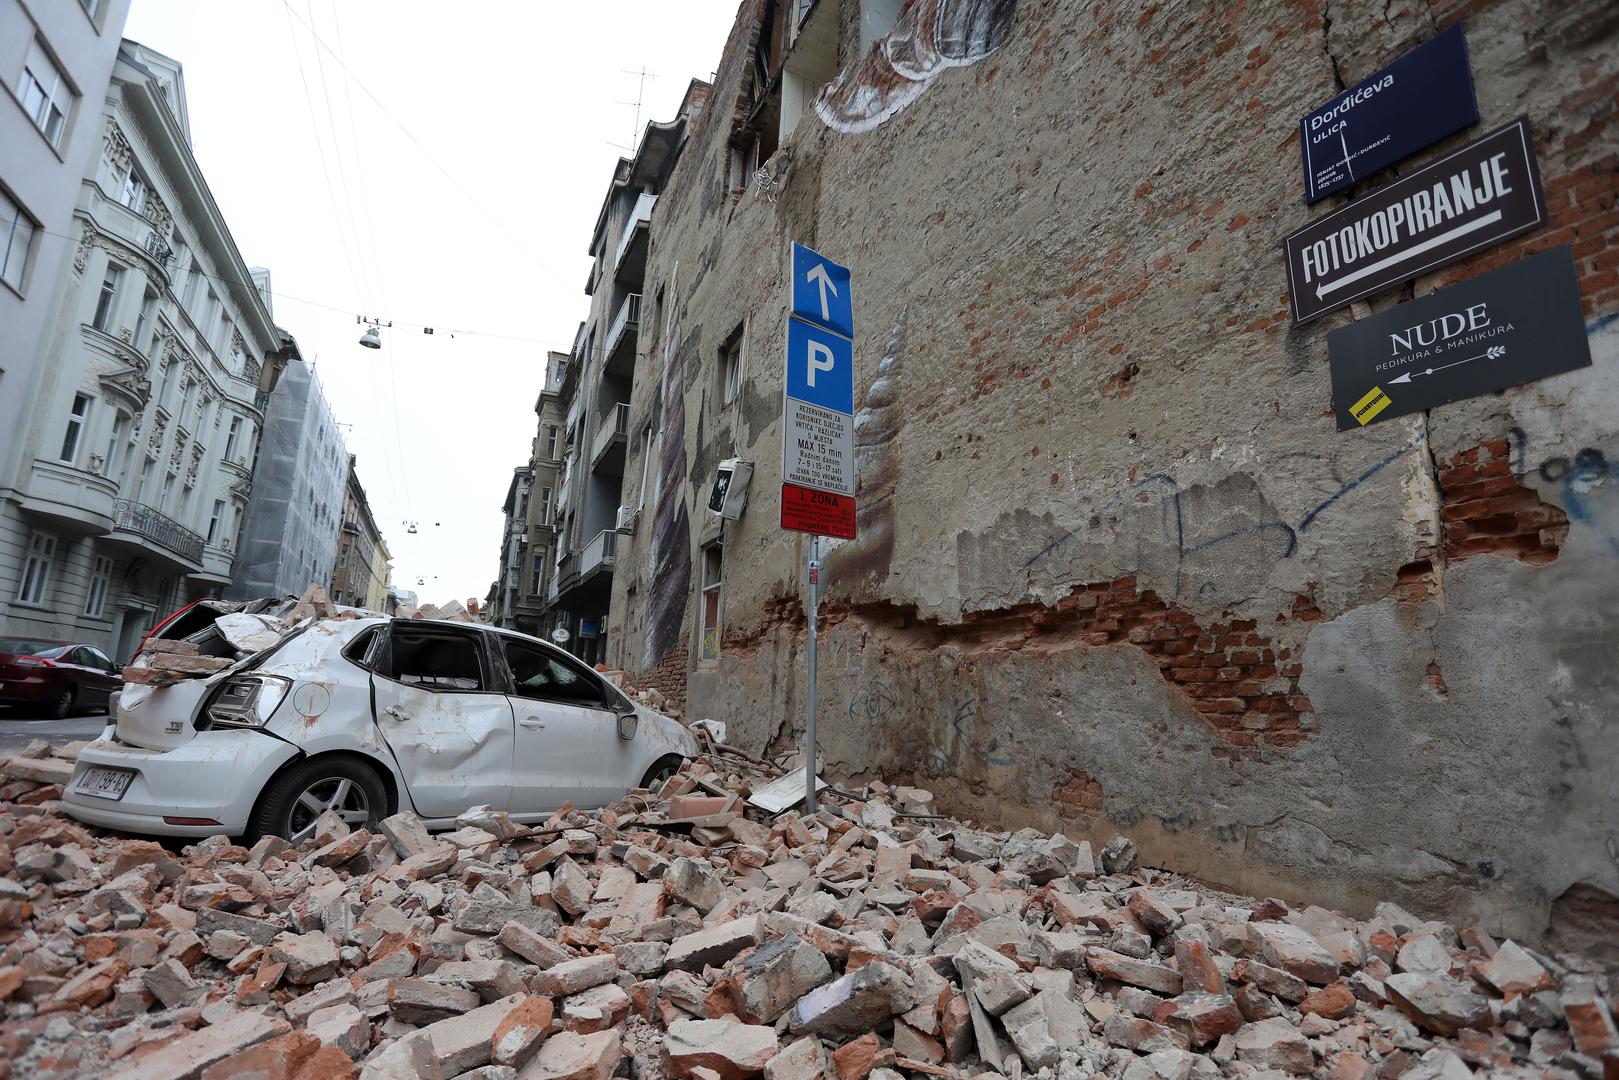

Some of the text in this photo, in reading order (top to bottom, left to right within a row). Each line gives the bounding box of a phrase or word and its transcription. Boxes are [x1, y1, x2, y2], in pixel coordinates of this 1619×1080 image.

[1311, 74, 1395, 131] Đorđićeva
[1313, 120, 1347, 144] ULICA
[1301, 152, 1513, 283] FOTOKOPIRANJE
[1388, 303, 1491, 356] NUDE
[1375, 323, 1515, 372] PEDIKURA & MANIKURA
[807, 339, 834, 388] P
[796, 411, 821, 425] KORISNIKE
[799, 404, 832, 420] REZERVIRANO
[813, 433, 832, 444] MJESTA
[798, 438, 842, 459] MAX 15 min
[800, 450, 840, 466] Radnim danom
[790, 473, 816, 485] PARKIRANJE
[796, 467, 809, 475] IZVAN
[821, 473, 842, 483] VREMENA
[832, 467, 842, 475] sati
[811, 492, 839, 507] ZONA
